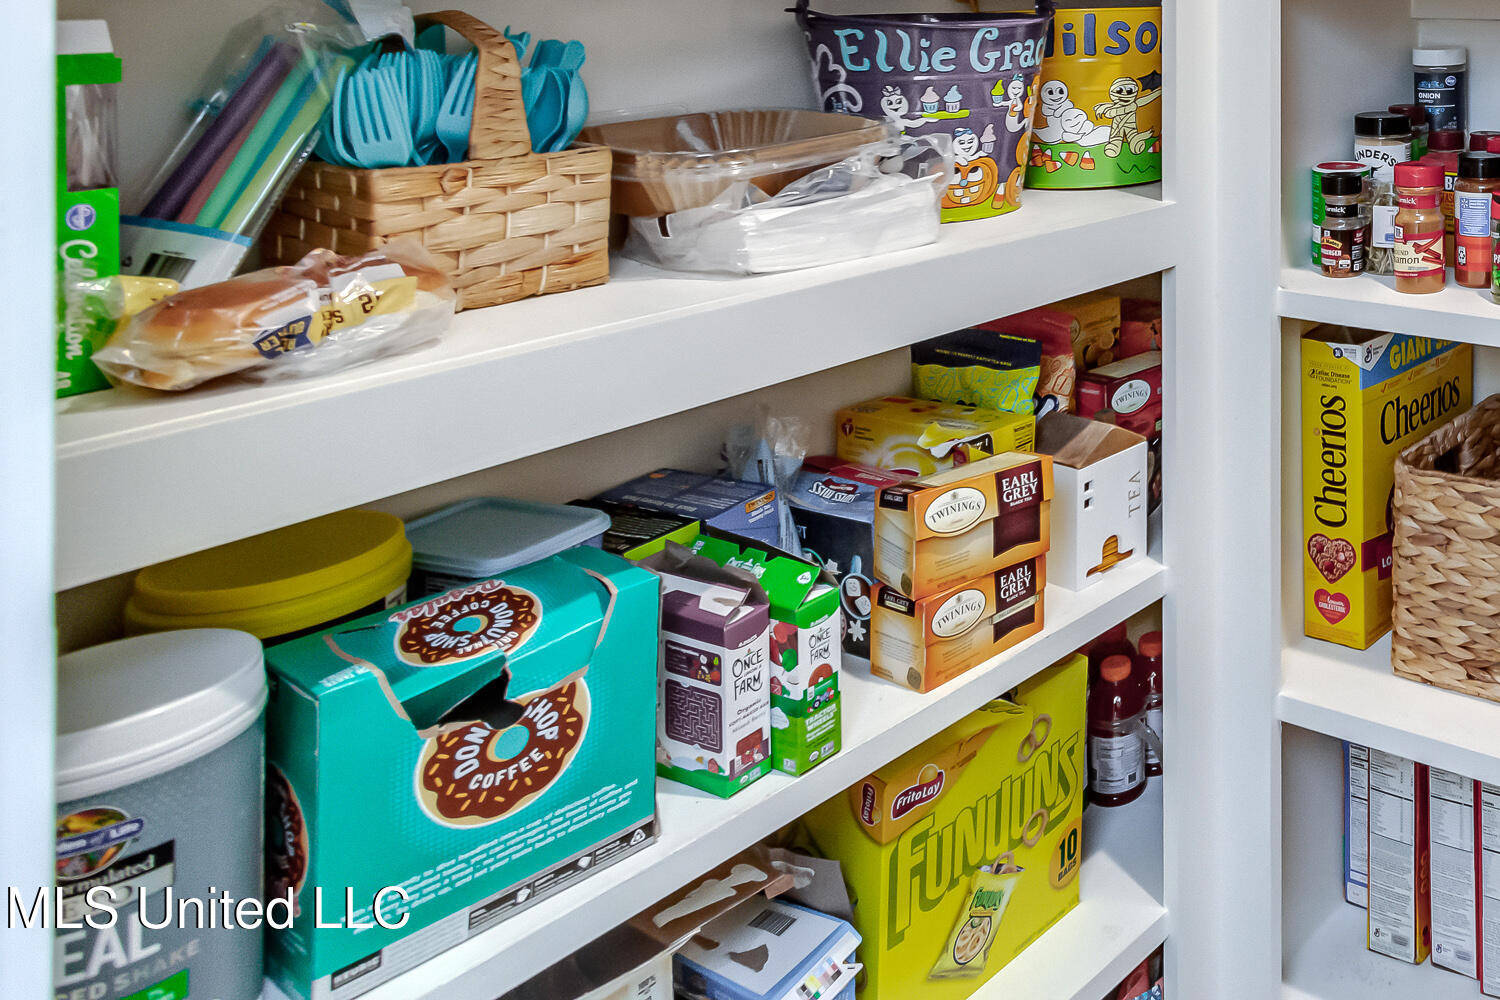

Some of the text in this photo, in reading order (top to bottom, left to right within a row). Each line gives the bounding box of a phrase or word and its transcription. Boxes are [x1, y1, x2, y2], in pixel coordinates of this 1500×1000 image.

[833, 28, 957, 73] Ellie
[1047, 13, 1162, 58] ilso
[1355, 149, 1399, 168] INDER'S
[1394, 257, 1420, 265] amon
[1389, 335, 1433, 371] GIANT
[1114, 389, 1149, 407] TWININGS
[1380, 375, 1461, 446] Cheerios
[1313, 394, 1348, 528] Cheerios
[1001, 471, 1039, 492] EARL
[1002, 482, 1039, 504] GREY
[929, 501, 982, 523] TWININGS
[1000, 564, 1032, 589] EARL
[1000, 575, 1032, 599] GREY
[388, 579, 506, 624] Regular
[430, 599, 491, 630] COFFEE
[936, 601, 982, 630] TWININGS
[423, 631, 474, 649] SHOP
[808, 627, 832, 649] ONCE
[731, 647, 764, 678] ONCE
[809, 644, 832, 665] FARM
[733, 670, 764, 701] FARM
[736, 697, 762, 715] Organic
[453, 726, 491, 780] DON
[467, 747, 545, 791] COFFEE
[1058, 827, 1079, 871] 10
[1057, 857, 1078, 883] BAGS
[57, 911, 162, 984] EAL
[113, 938, 200, 992] SHAKE
